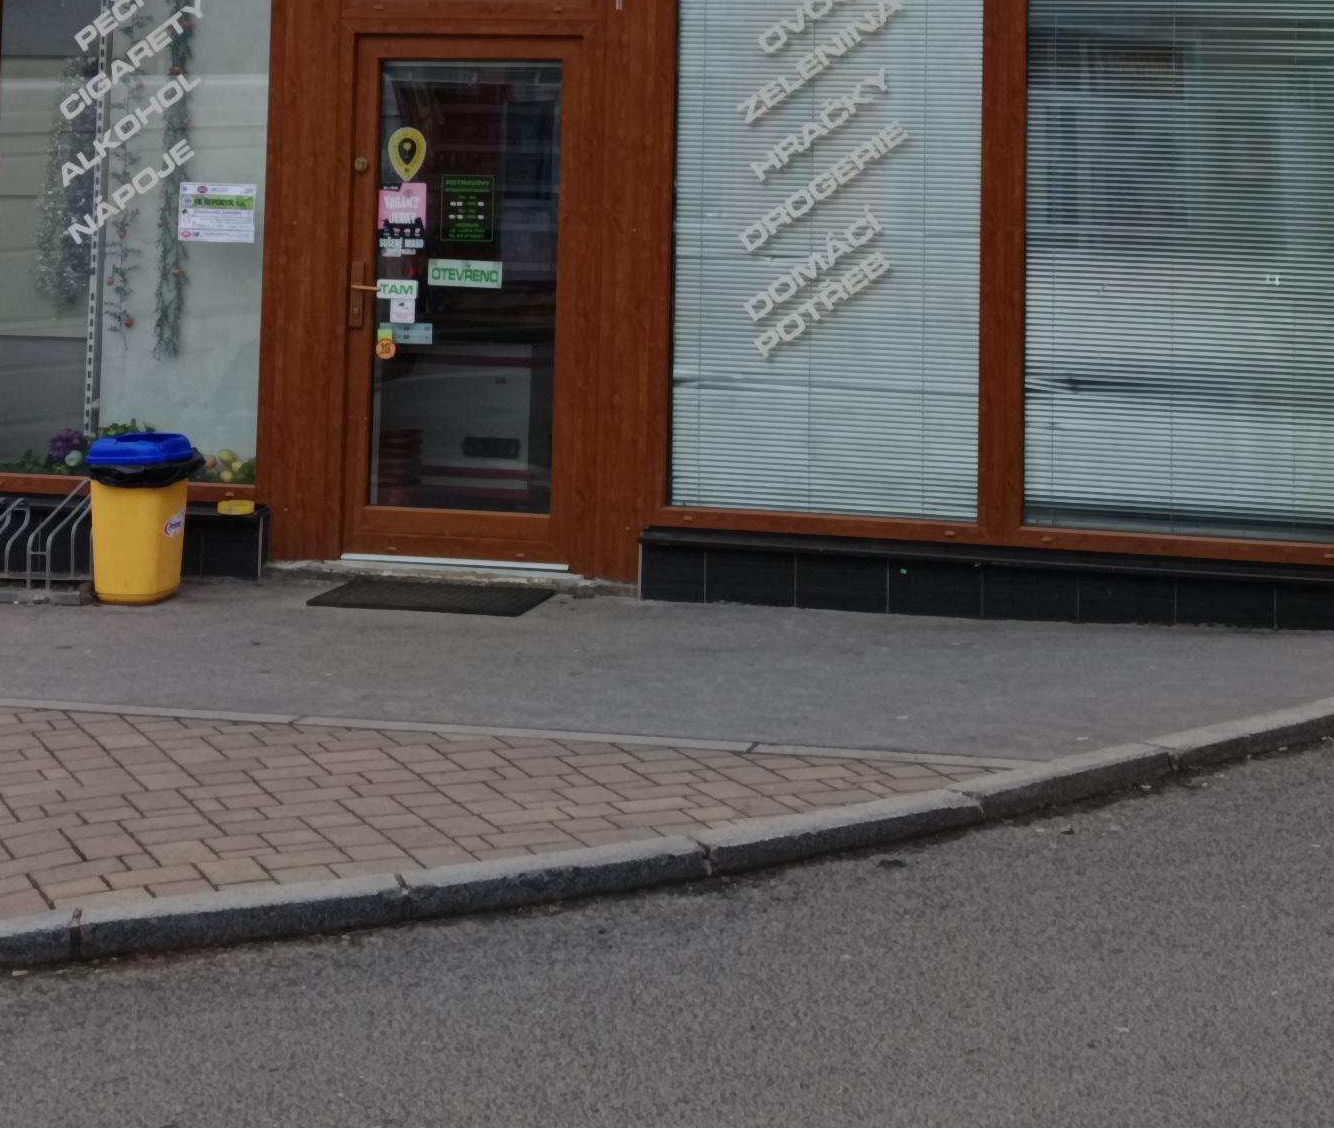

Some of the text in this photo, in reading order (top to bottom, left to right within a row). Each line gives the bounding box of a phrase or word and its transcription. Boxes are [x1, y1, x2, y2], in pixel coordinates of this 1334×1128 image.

[59, 73, 202, 188] ALKOHOL
[750, 67, 890, 183] HRAČKY
[65, 138, 196, 245] NÁPOJE
[738, 120, 910, 253] DROGERIE
[380, 283, 413, 296] TAM
[431, 264, 499, 283] OTEVŘENO
[742, 205, 884, 322] DOMÁCÍ
[753, 250, 891, 359] POTŘEB
